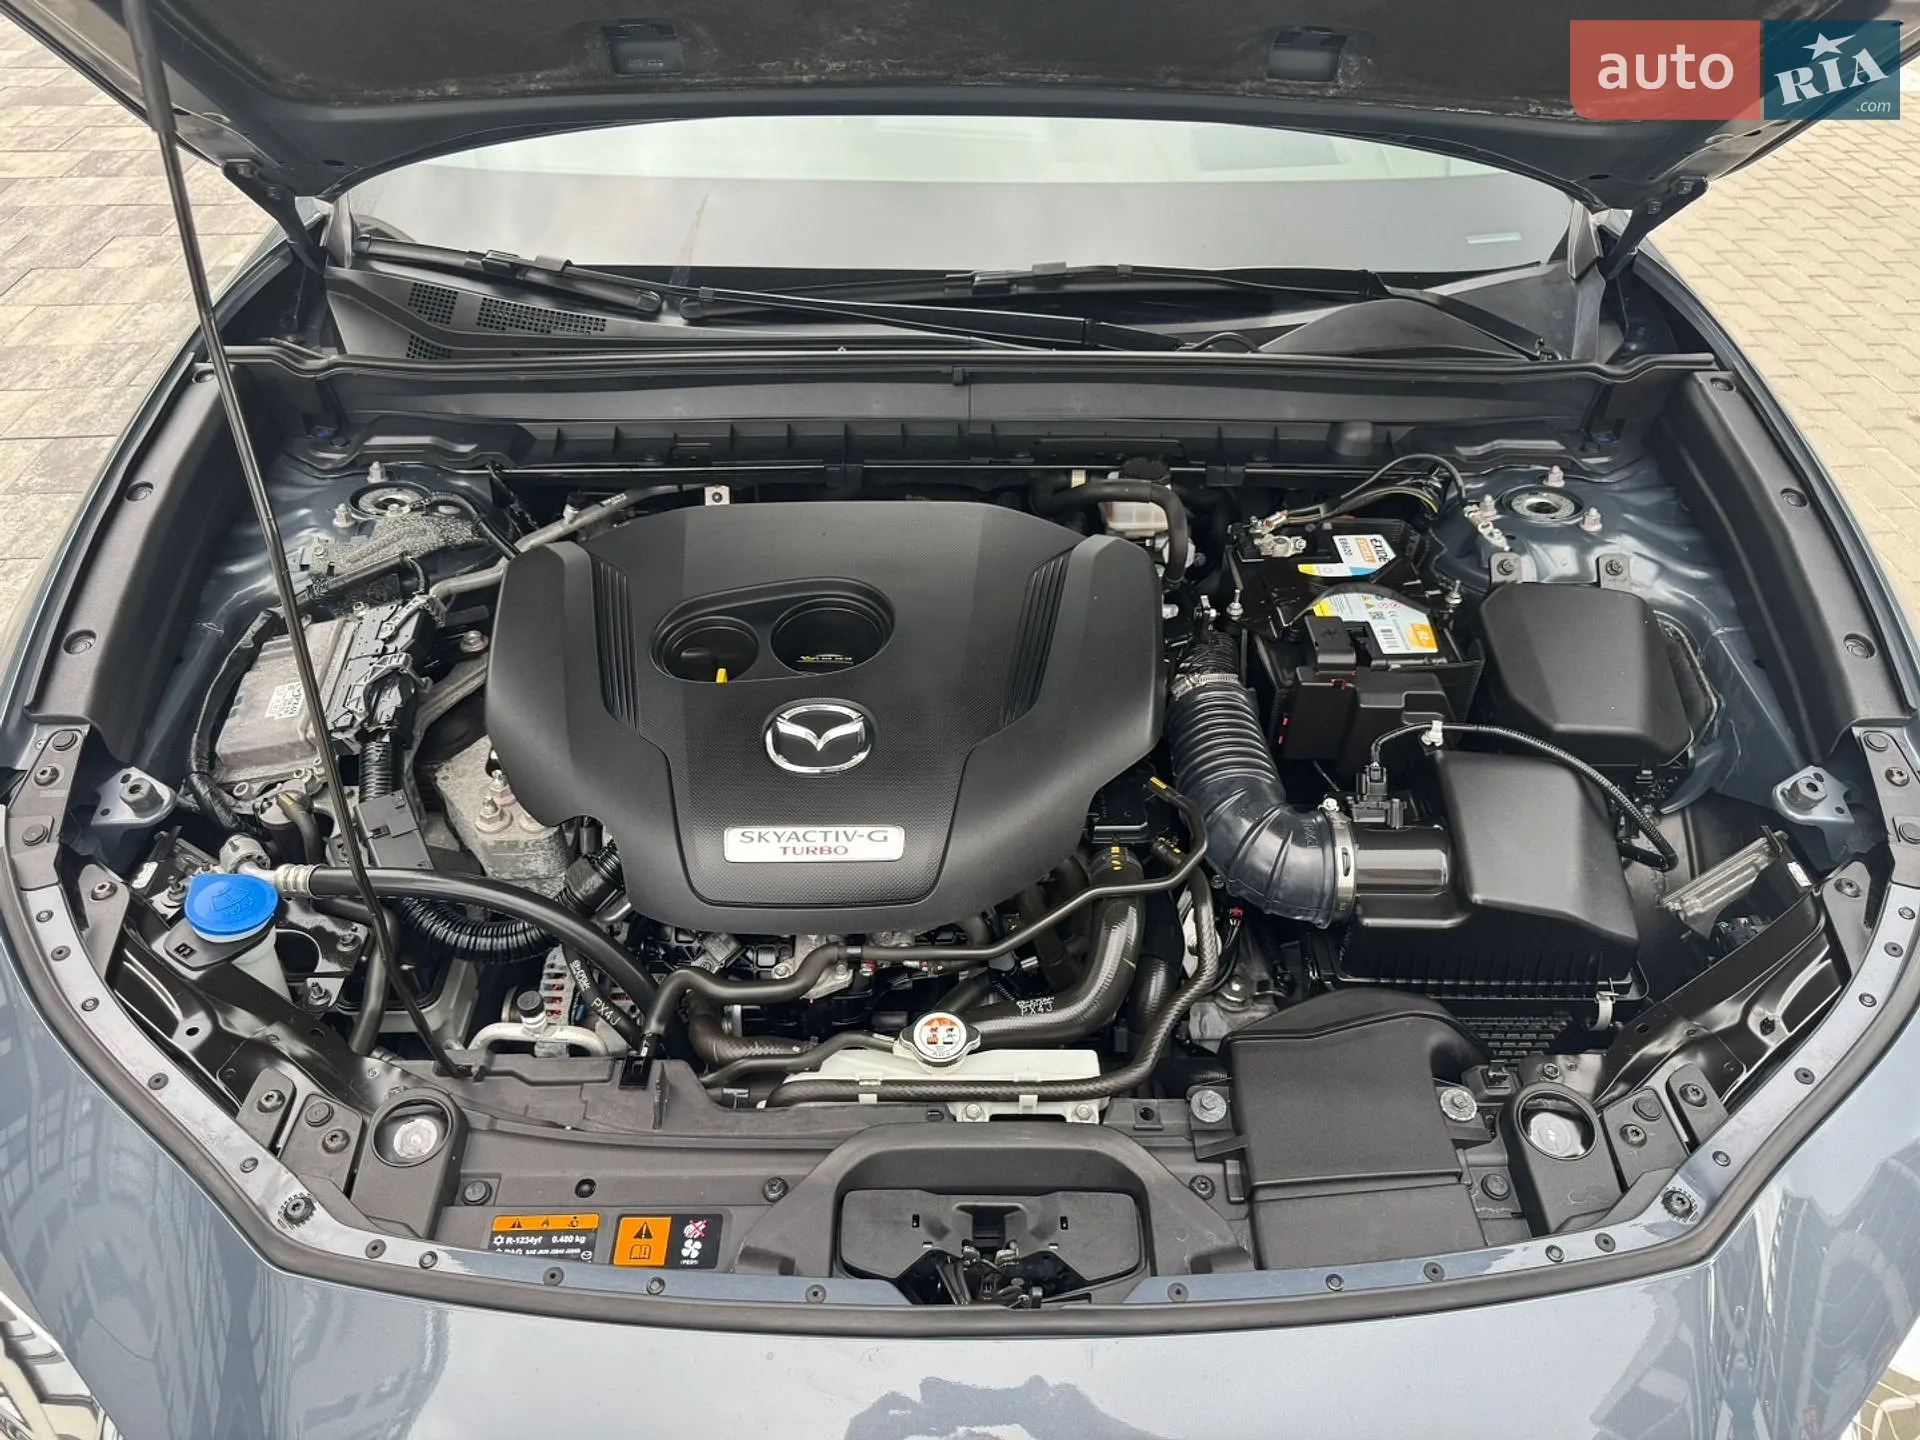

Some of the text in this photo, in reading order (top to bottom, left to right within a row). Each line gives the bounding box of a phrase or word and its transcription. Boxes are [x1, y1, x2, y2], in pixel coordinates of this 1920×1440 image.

[1370, 538, 1390, 563] EXIDE
[739, 830, 889, 843] SKYACTIV-G
[780, 846, 849, 856] TURBO
[591, 997, 621, 1026] PX4J
[505, 1236, 543, 1245] R-1234yf
[575, 1235, 586, 1244] kg
